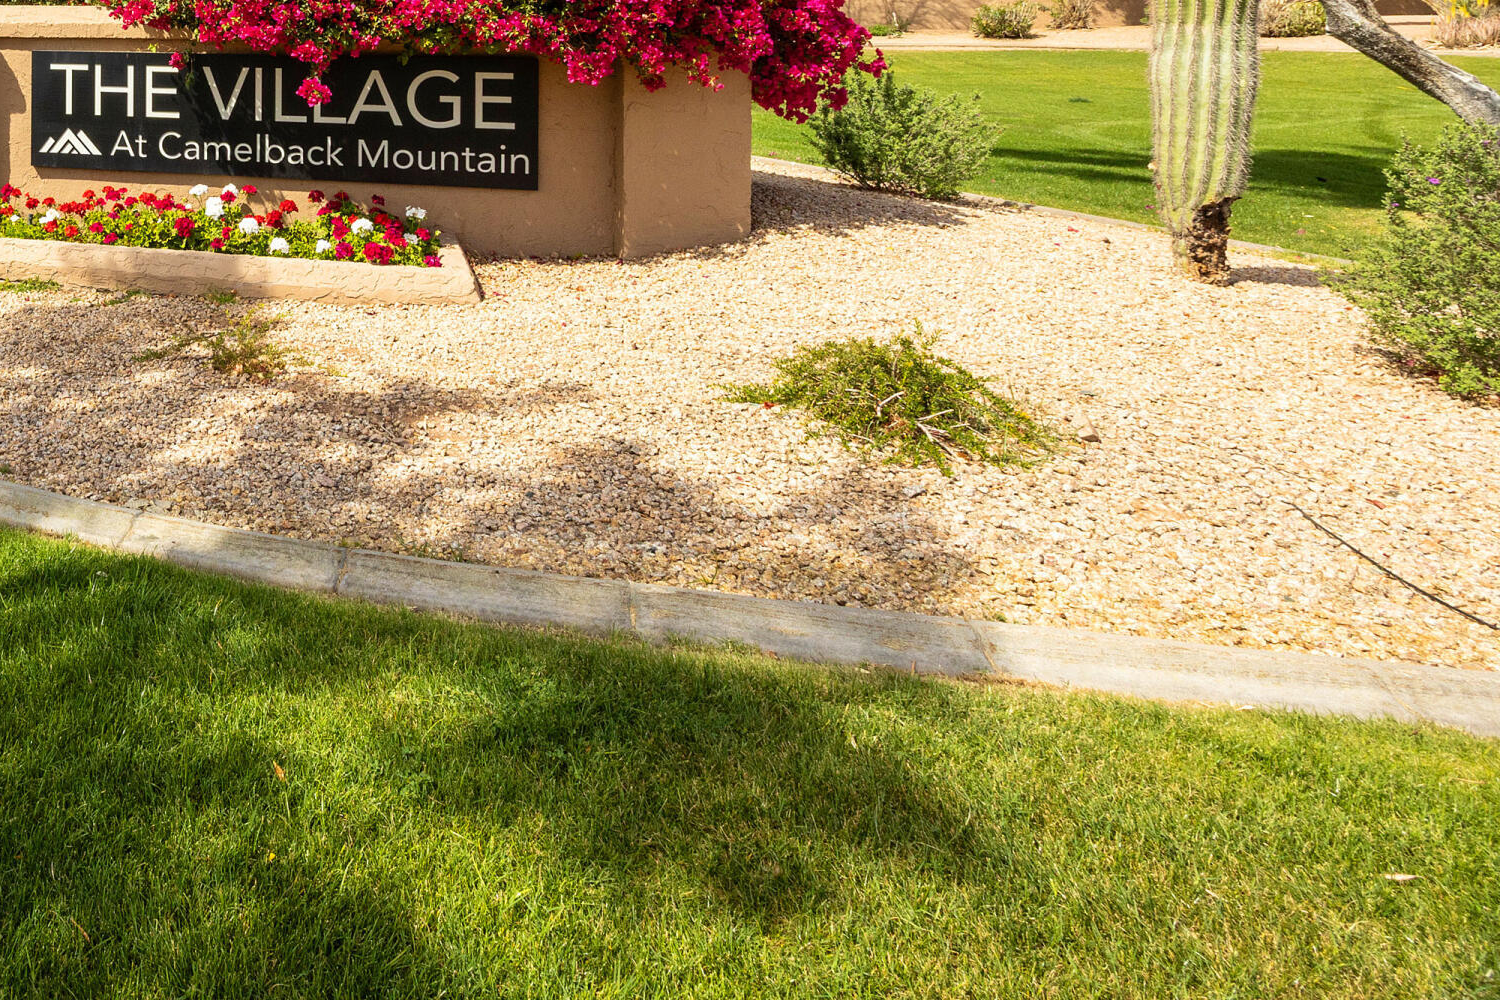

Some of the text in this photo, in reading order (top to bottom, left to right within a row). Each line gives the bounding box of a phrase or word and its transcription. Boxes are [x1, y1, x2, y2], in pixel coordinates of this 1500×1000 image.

[50, 63, 180, 119] THE
[110, 130, 530, 175] At Camelback Mountain
